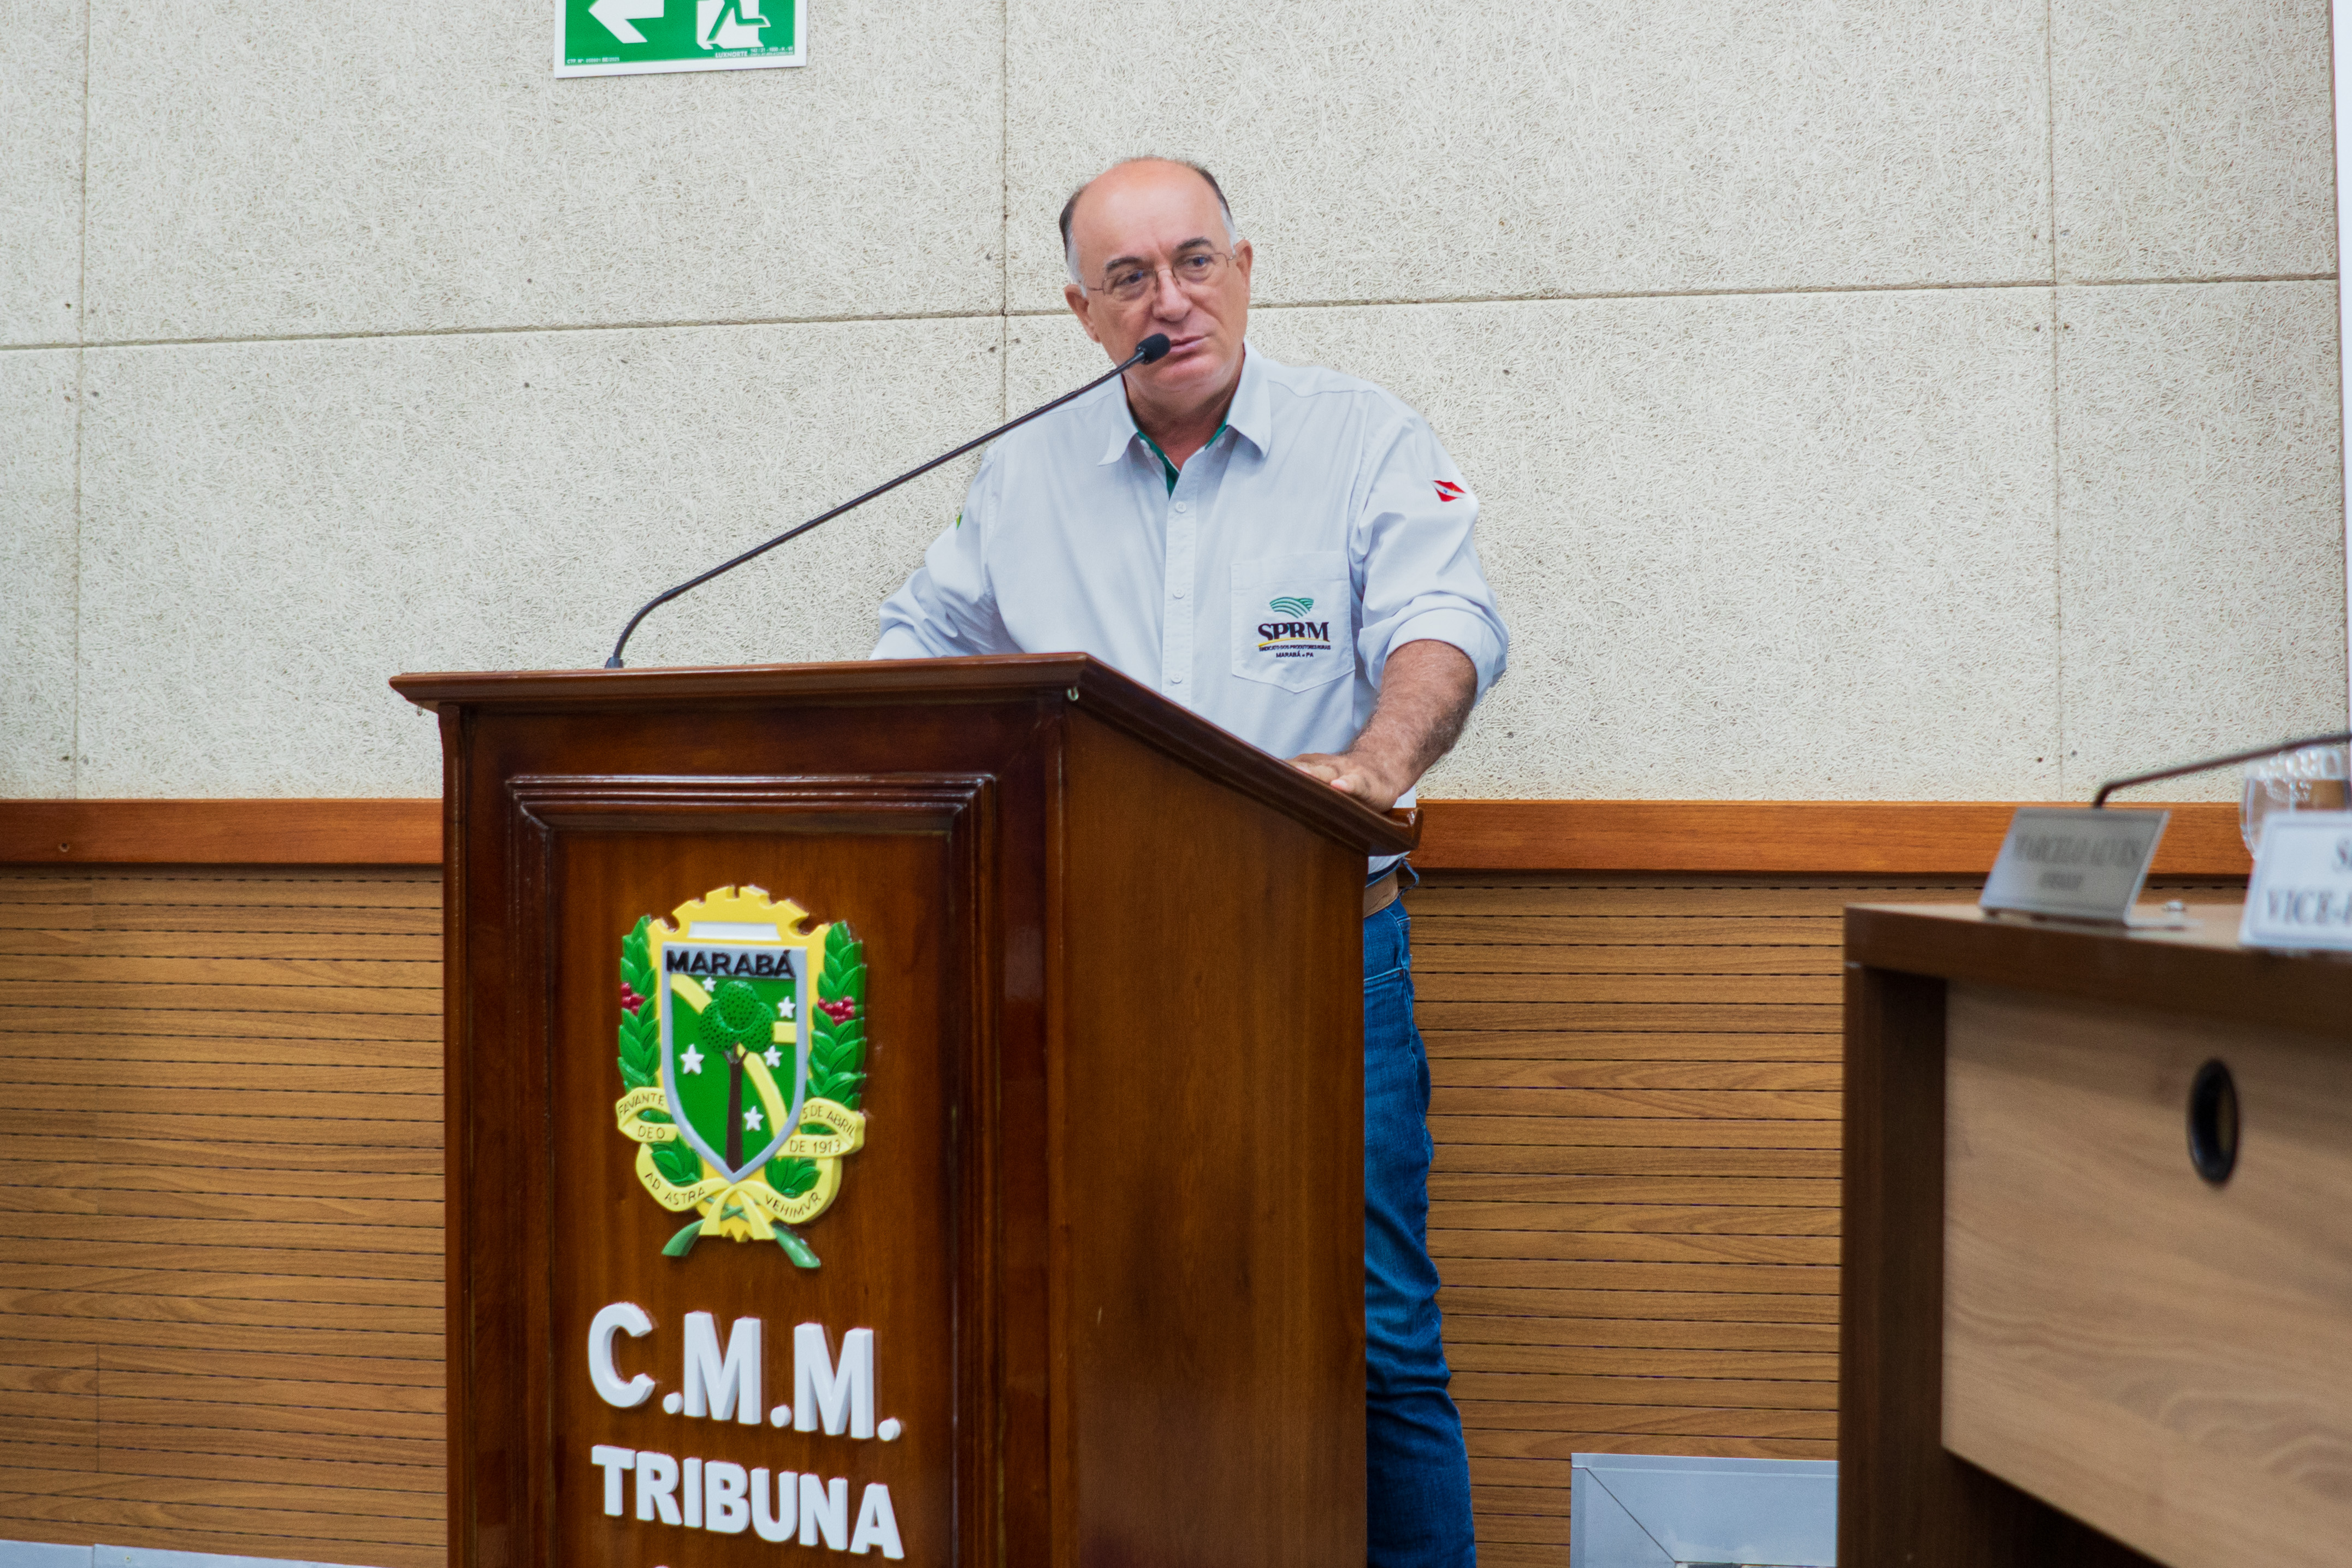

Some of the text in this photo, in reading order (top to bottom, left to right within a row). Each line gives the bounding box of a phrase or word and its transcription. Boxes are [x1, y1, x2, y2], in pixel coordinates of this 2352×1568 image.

[1258, 622, 1330, 642] SPRM
[666, 949, 796, 978] MARABÁ
[618, 1093, 665, 1115] FAVANTE
[638, 1125, 665, 1139] DEO
[811, 1105, 824, 1117] DE
[826, 1110, 855, 1138] ABRIL
[789, 1139, 841, 1153] DE 1913
[645, 1173, 705, 1205] AD ASTRA
[766, 1192, 822, 1218] VEHIMVR
[588, 1301, 902, 1441] C.M.M.
[592, 1445, 905, 1559] TRIBUNA
